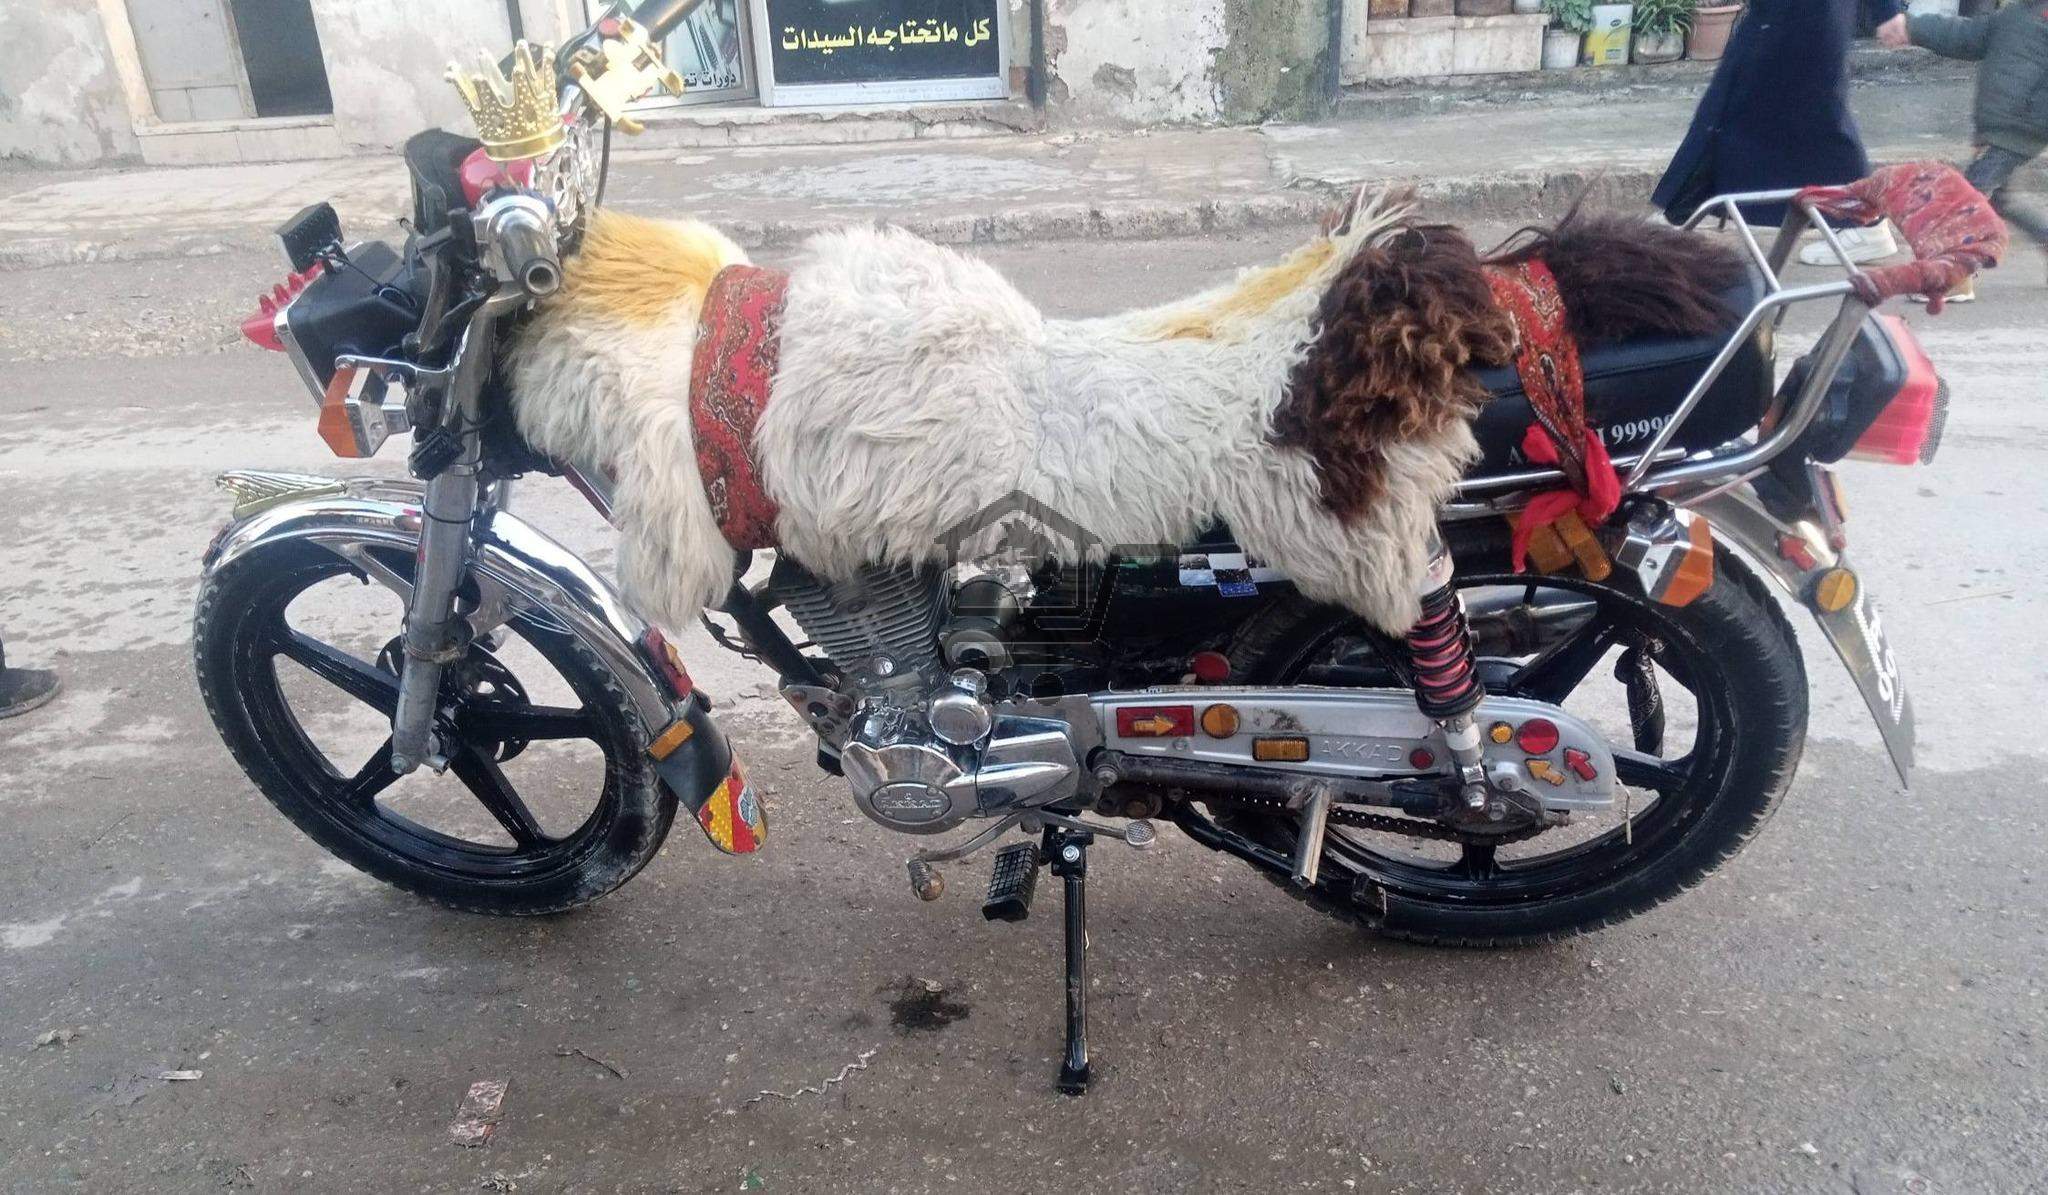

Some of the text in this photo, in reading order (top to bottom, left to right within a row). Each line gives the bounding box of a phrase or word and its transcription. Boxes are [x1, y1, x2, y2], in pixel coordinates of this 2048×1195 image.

[782, 18, 990, 55] كل ماتحتاجه السيدات
[702, 71, 737, 88] دورات
[1320, 740, 1403, 761] AKKAD
